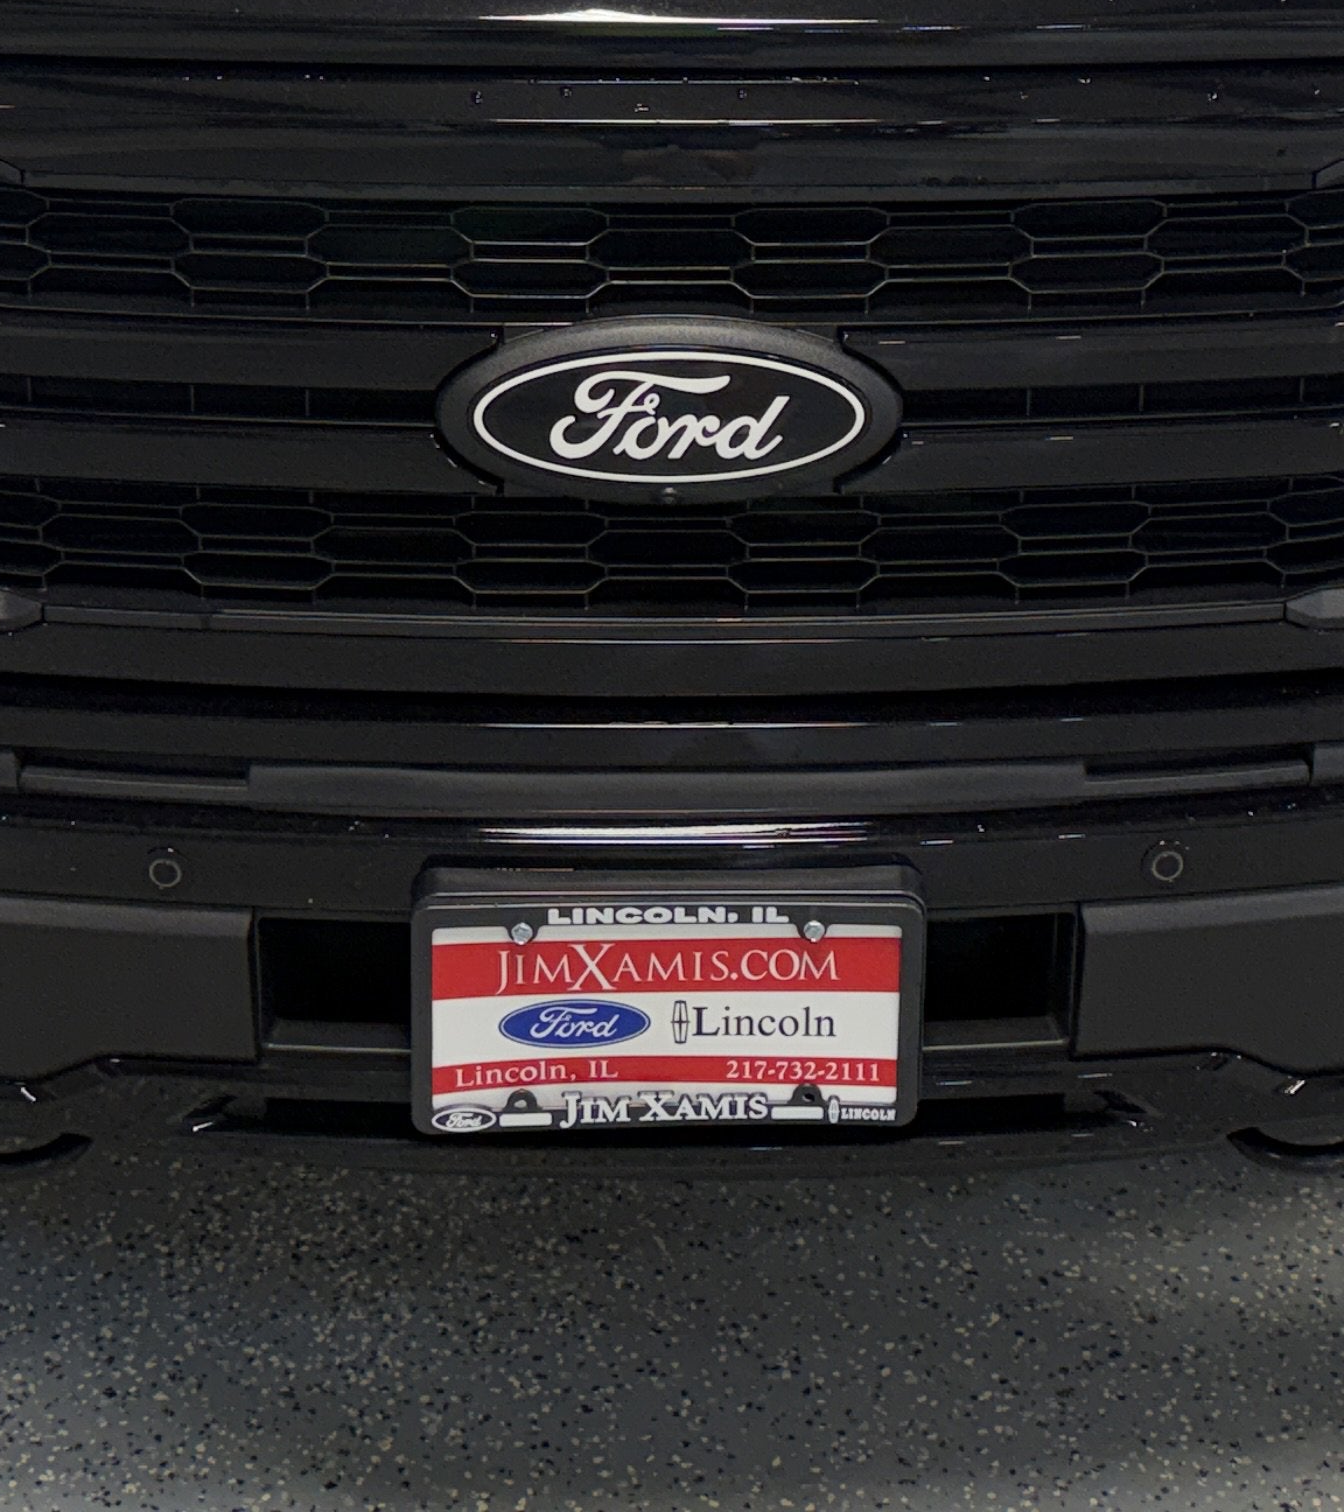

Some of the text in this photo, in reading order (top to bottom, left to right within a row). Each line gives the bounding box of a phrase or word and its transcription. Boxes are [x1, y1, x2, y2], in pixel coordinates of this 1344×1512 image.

[549, 370, 791, 461] Ford
[547, 906, 790, 926] LINCOLN, IL
[529, 1006, 618, 1039] Ford
[691, 1005, 837, 1038] Lincoln
[455, 1059, 619, 1088] Lincoln, IL
[725, 1059, 881, 1083] 217-732-2111
[445, 1112, 483, 1128] Ford
[559, 1090, 769, 1129] JIM XAMIS
[840, 1108, 897, 1121] LINCOLN
